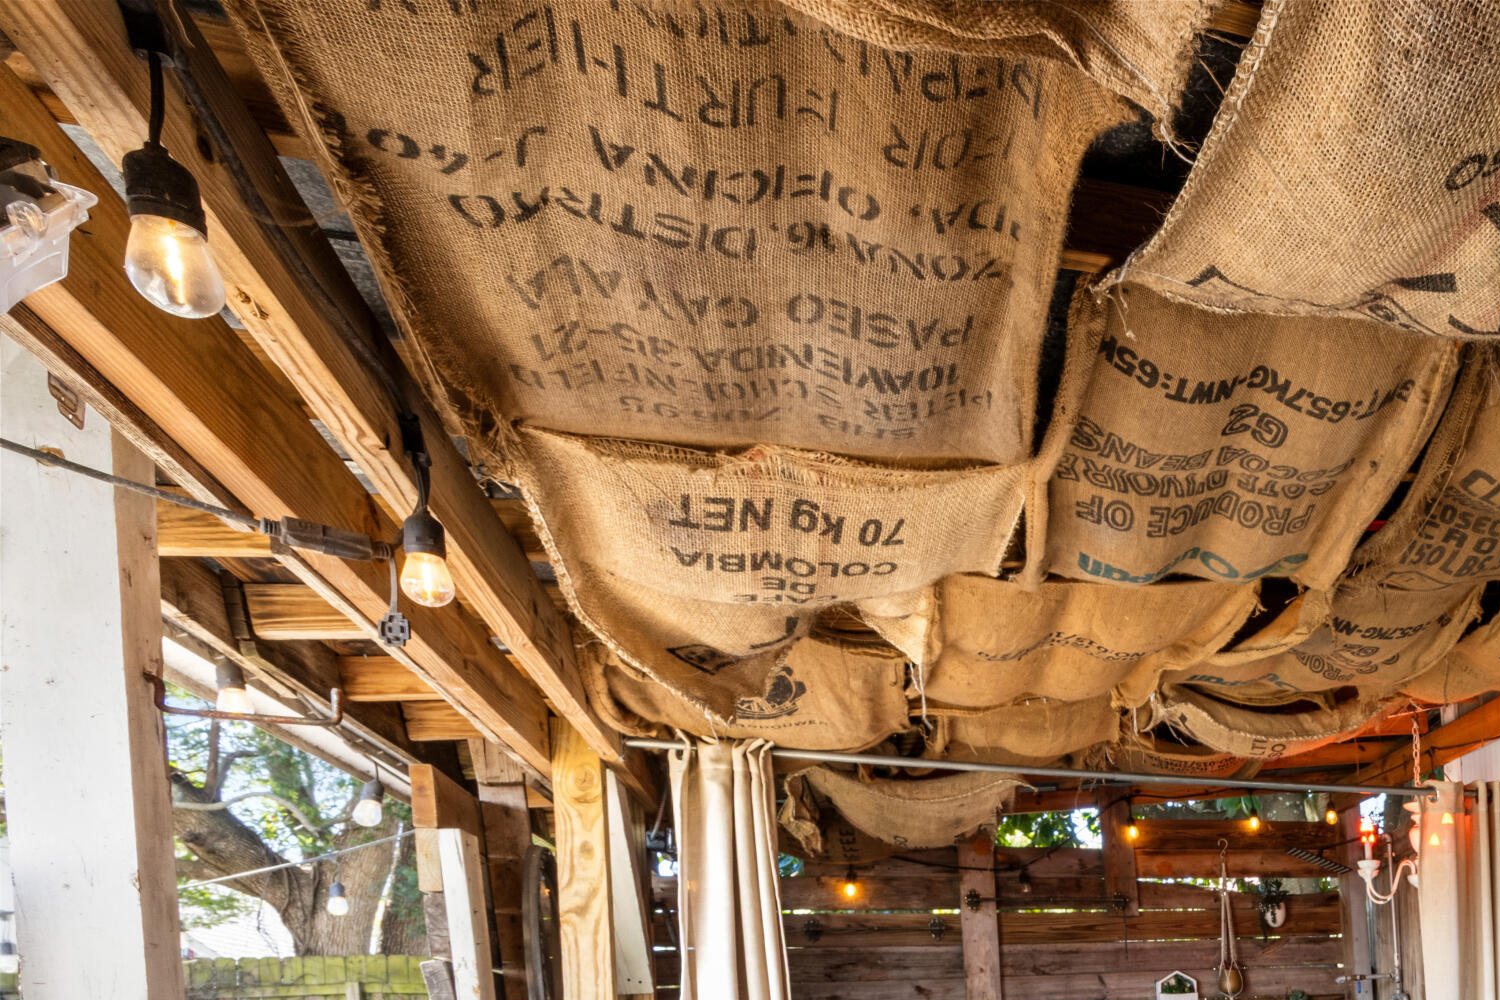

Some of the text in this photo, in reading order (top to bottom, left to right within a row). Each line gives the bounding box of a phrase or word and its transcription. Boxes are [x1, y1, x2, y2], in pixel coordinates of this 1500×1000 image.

[466, 7, 1014, 171] FOR FURTHER
[588, 125, 881, 222] OFICINA
[786, 293, 974, 351] PASEO
[1069, 416, 1356, 483] COCOA BEANS
[1220, 403, 1290, 449] G2
[1236, 470, 1337, 500] COTE
[668, 494, 906, 547] 70 kg NET
[1074, 489, 1315, 539] PRODUCE OF
[669, 546, 899, 578] COLOMBIA
[760, 576, 817, 596] DE
